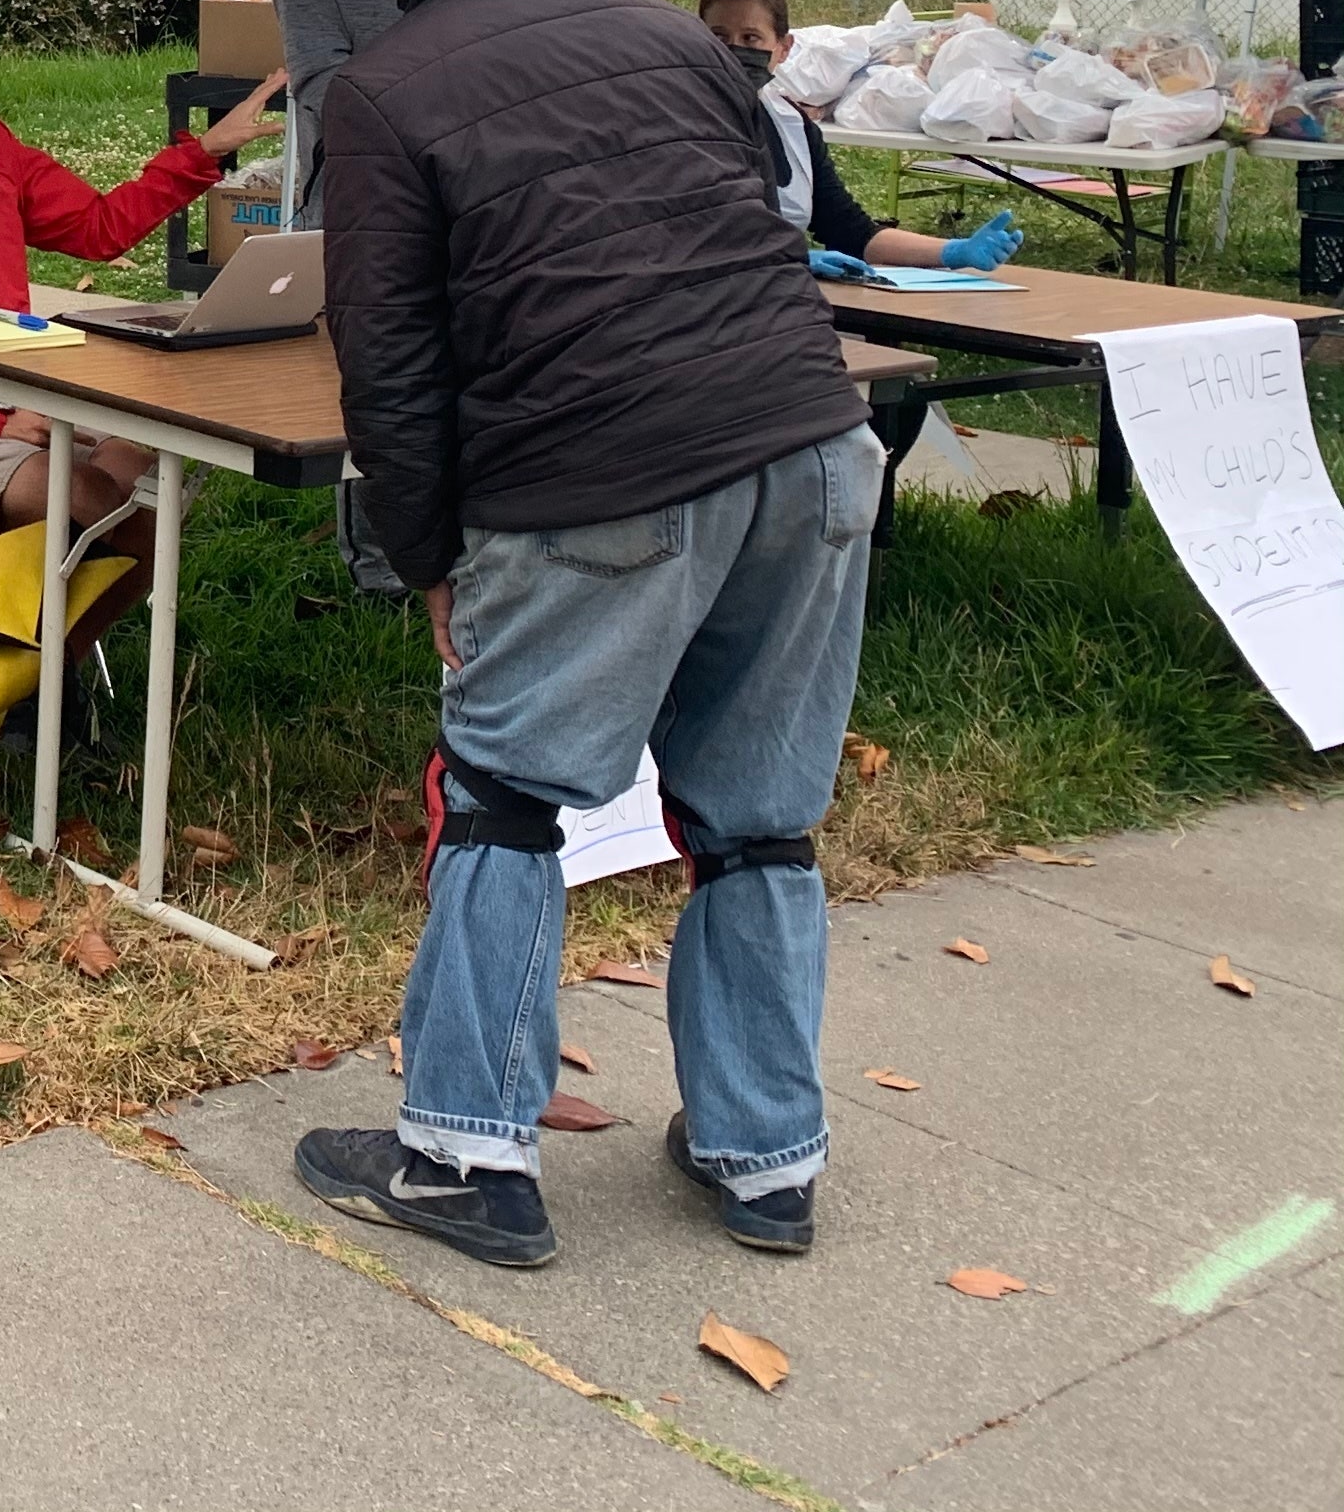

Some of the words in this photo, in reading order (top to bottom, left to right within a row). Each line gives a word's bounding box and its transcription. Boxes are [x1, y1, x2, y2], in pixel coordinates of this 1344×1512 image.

[1118, 363, 1161, 420] I
[1182, 350, 1287, 410] HAVE
[1146, 450, 1187, 502] MY
[1204, 427, 1312, 488] CHILD'S
